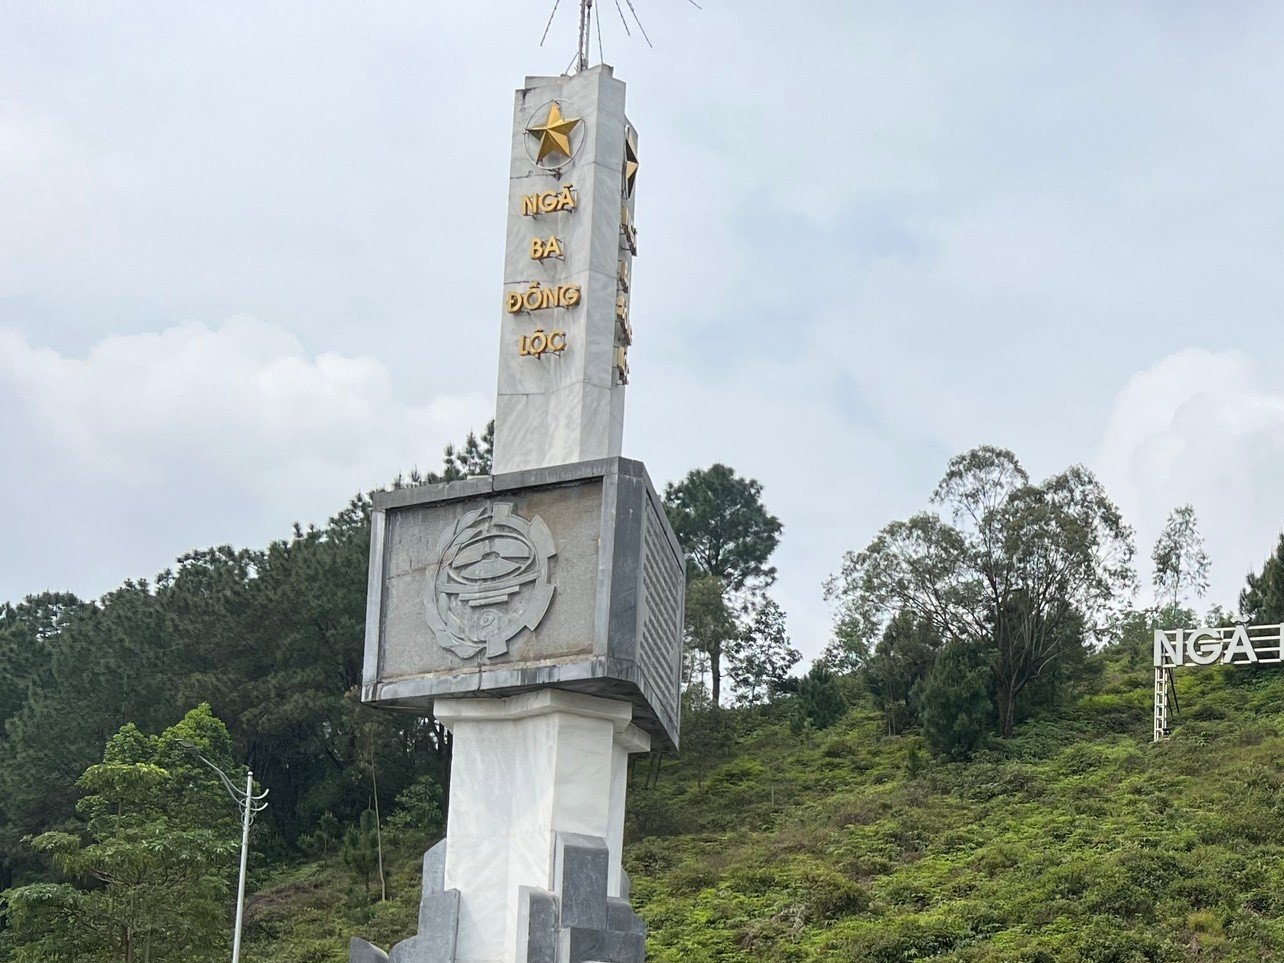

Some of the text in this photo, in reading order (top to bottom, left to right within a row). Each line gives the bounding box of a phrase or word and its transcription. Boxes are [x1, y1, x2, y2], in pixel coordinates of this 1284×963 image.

[521, 182, 576, 216] NGÃ
[530, 235, 563, 260] BA
[519, 327, 567, 359] LỘC
[1154, 615, 1257, 667] NGÃ
